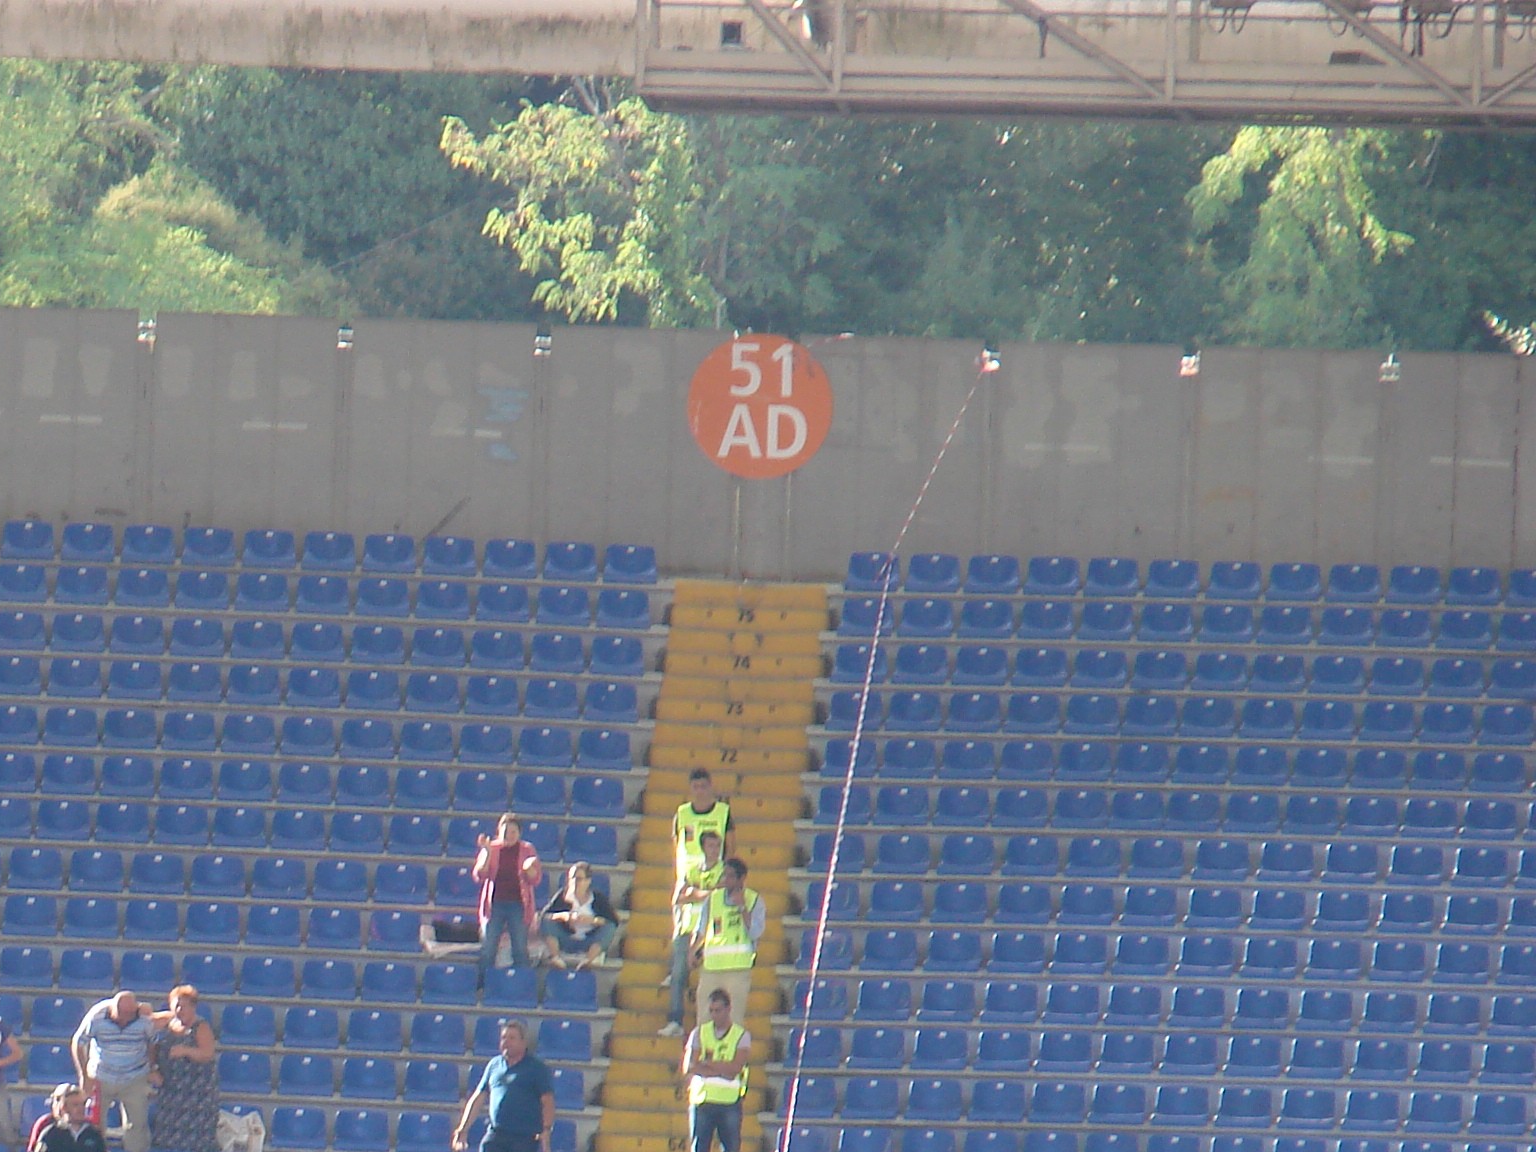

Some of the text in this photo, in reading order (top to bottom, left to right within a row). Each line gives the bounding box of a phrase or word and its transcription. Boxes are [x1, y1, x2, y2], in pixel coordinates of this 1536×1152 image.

[729, 342, 794, 398] 51
[716, 403, 808, 459] AD
[738, 607, 755, 623] 75
[733, 654, 751, 670] 74
[726, 700, 744, 716] 73
[720, 748, 738, 764] 72
